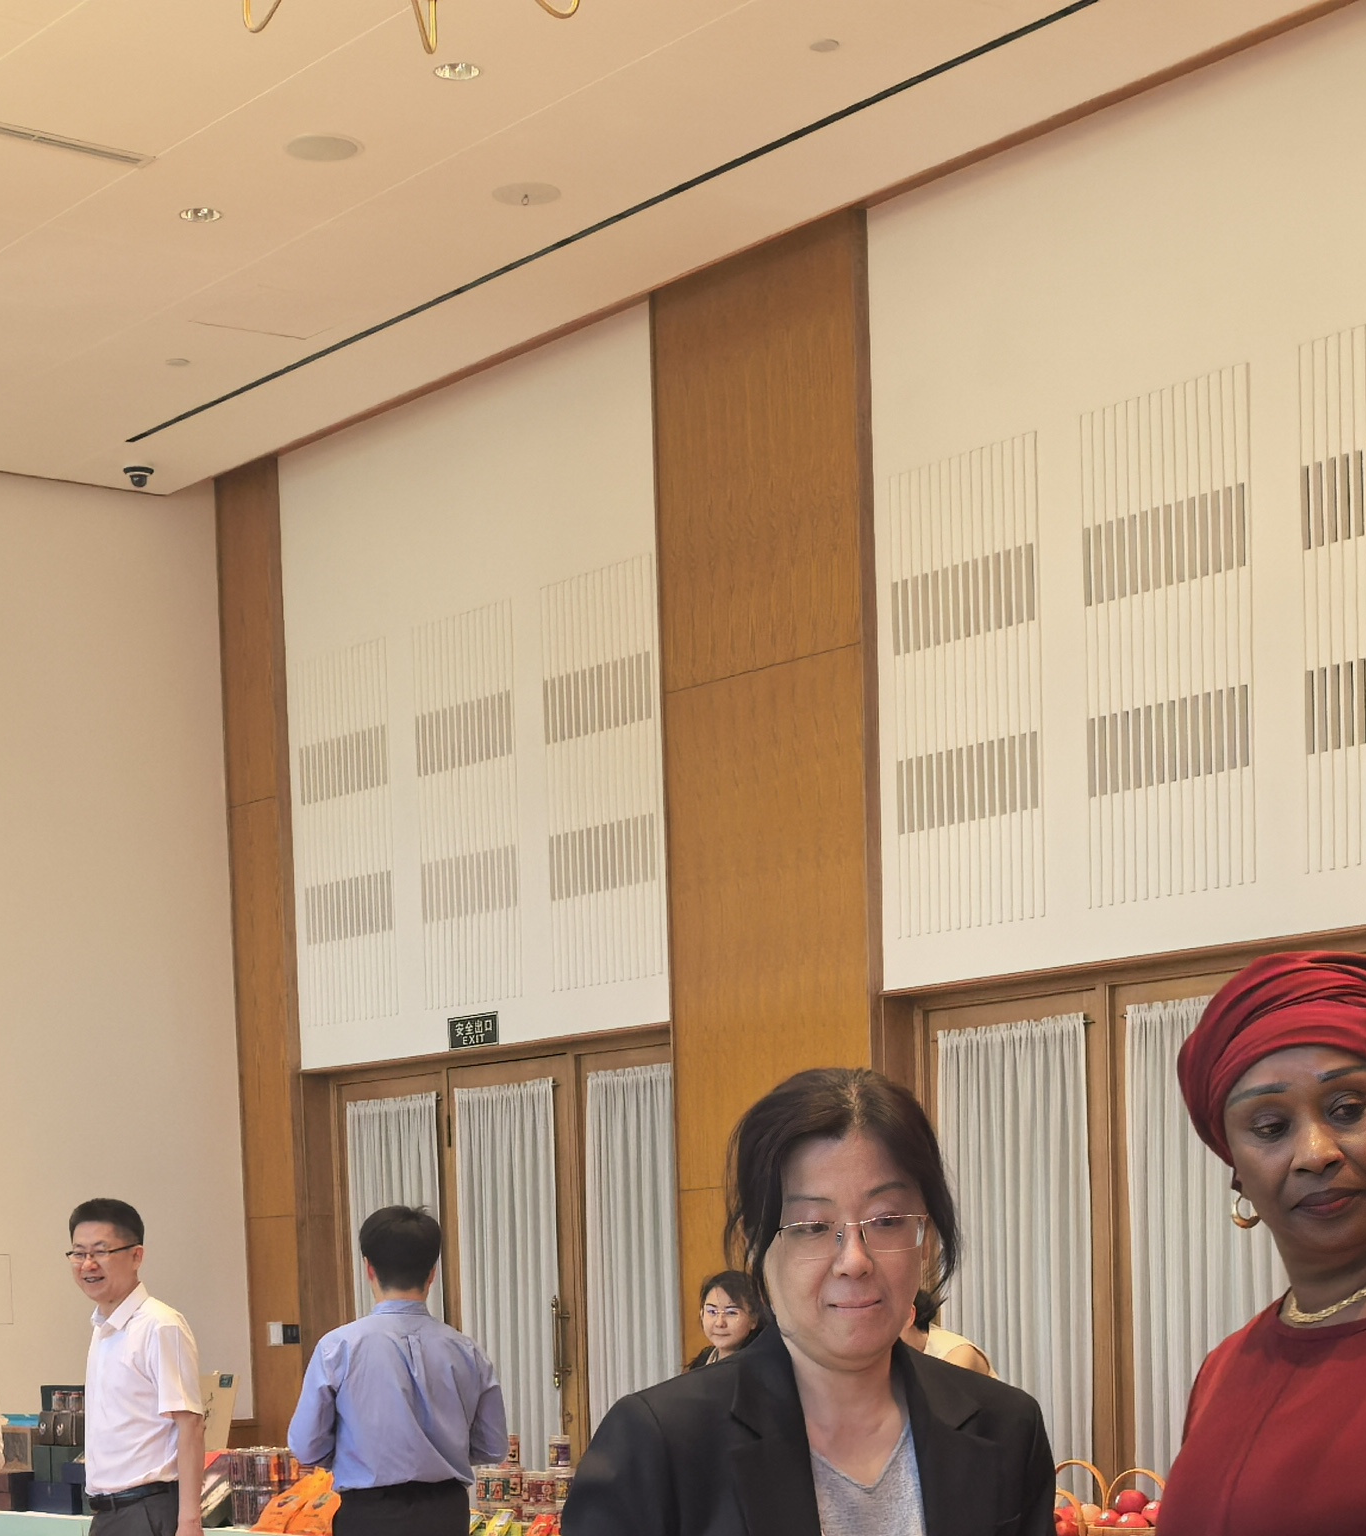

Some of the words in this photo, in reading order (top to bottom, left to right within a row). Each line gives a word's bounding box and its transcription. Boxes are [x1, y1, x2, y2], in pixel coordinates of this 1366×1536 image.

[455, 1020, 493, 1037] 安全出口
[462, 1034, 485, 1045] EXIT
